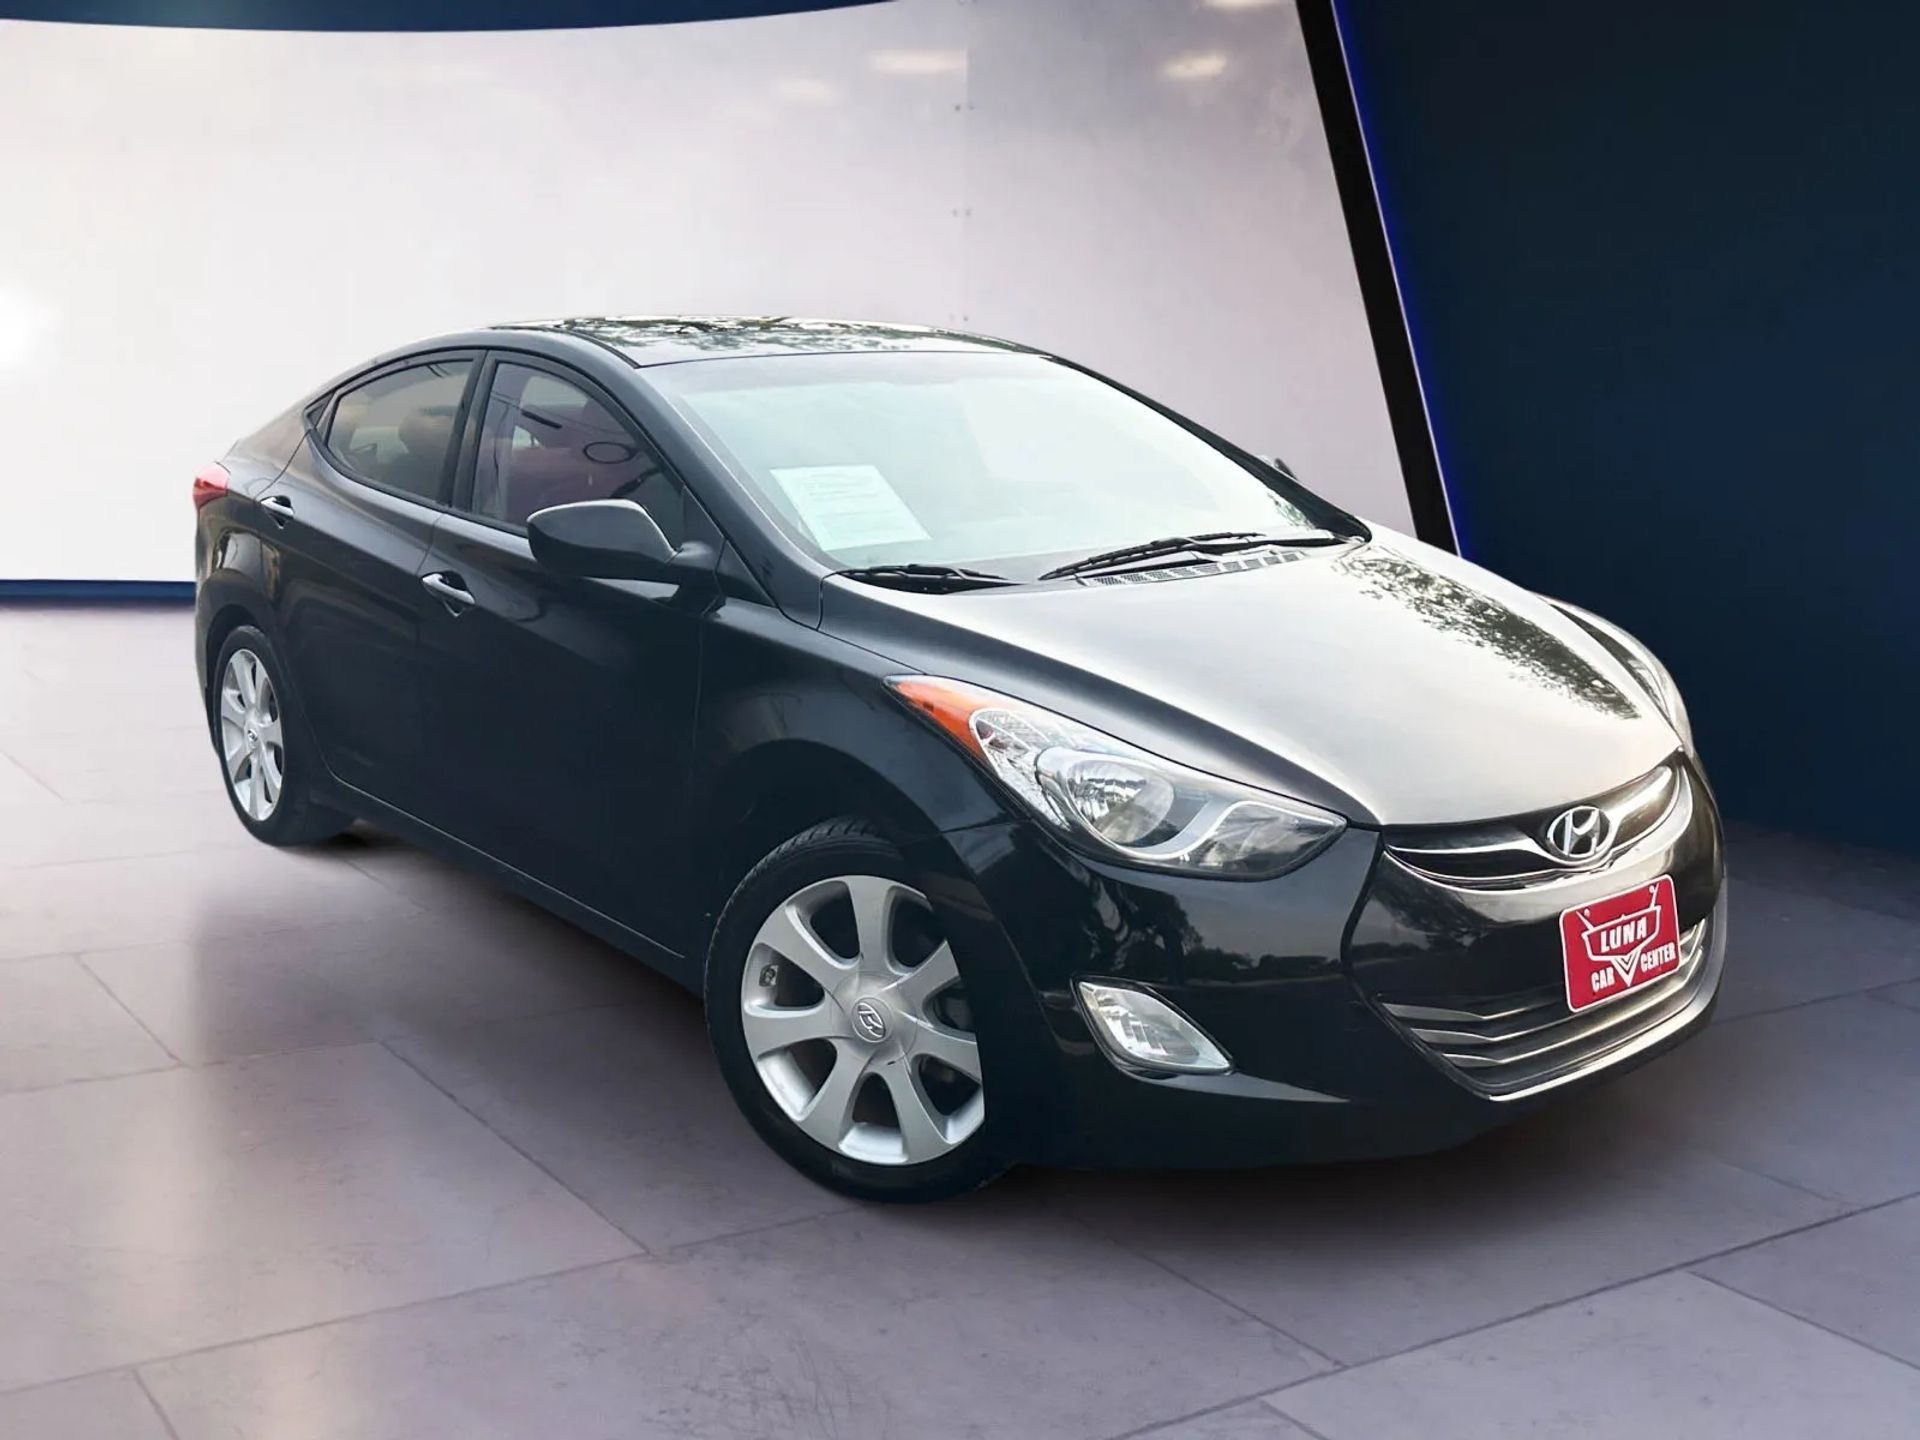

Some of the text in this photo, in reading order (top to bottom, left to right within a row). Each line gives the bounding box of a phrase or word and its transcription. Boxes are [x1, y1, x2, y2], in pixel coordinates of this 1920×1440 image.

[1600, 917, 1648, 953] LUNA
[1591, 942, 1677, 992] CAR CENTER
